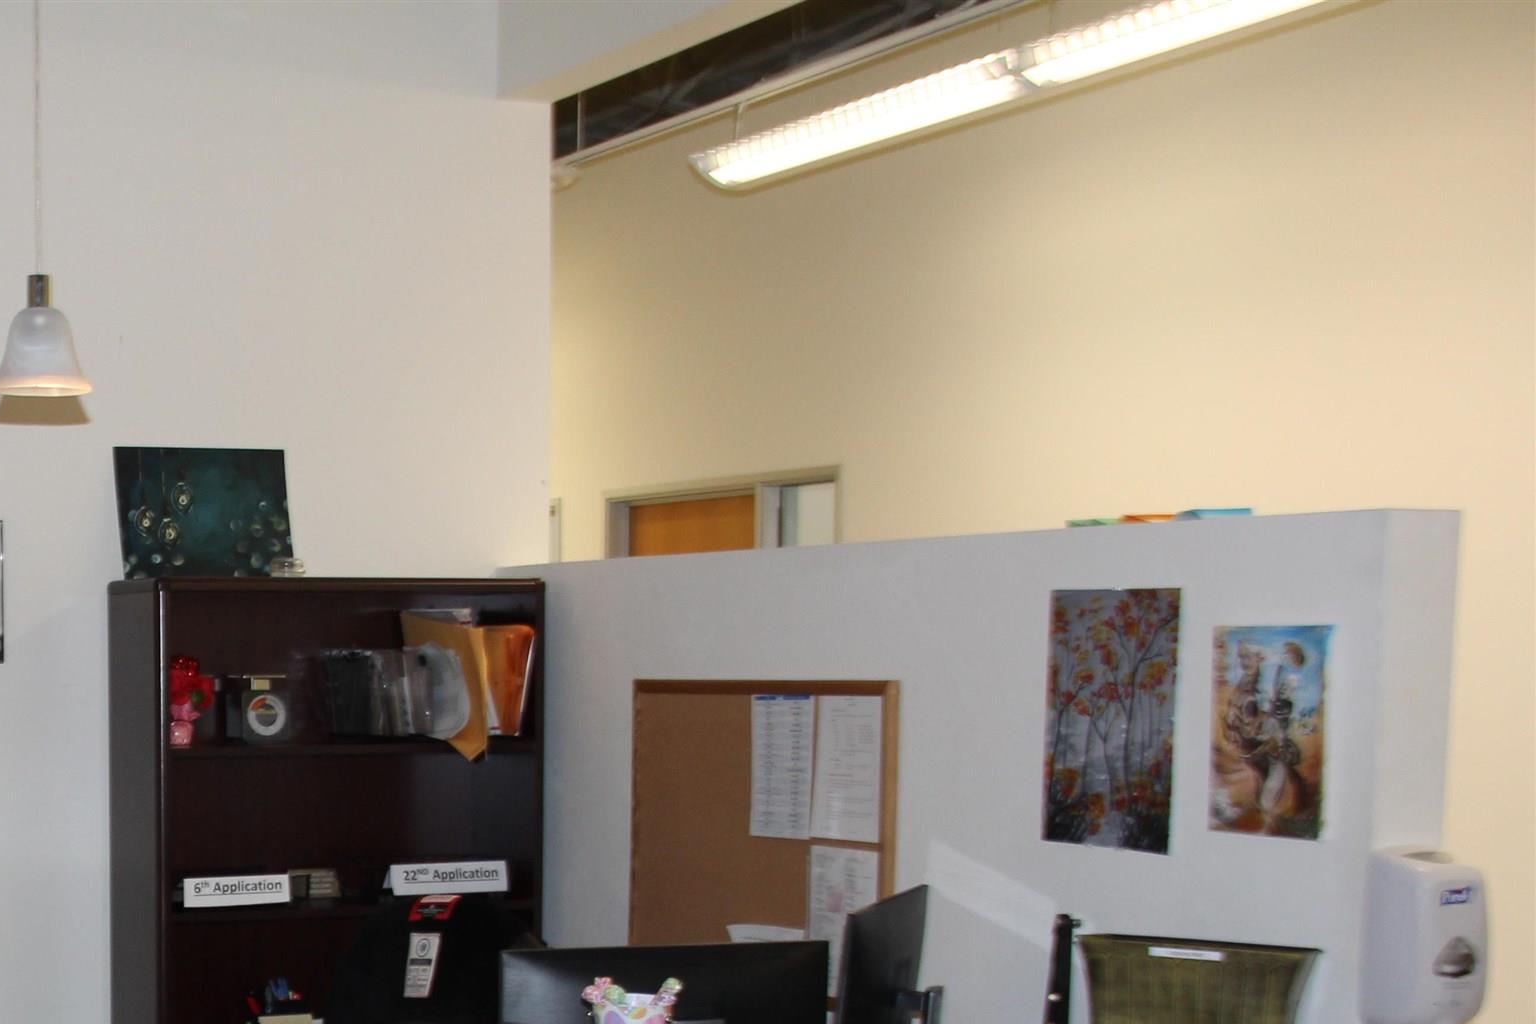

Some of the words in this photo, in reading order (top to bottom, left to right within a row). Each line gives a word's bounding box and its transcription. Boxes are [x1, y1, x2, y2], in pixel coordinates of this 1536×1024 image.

[403, 868, 430, 881] 22ND
[432, 867, 499, 882] Application
[213, 880, 282, 894] Application
